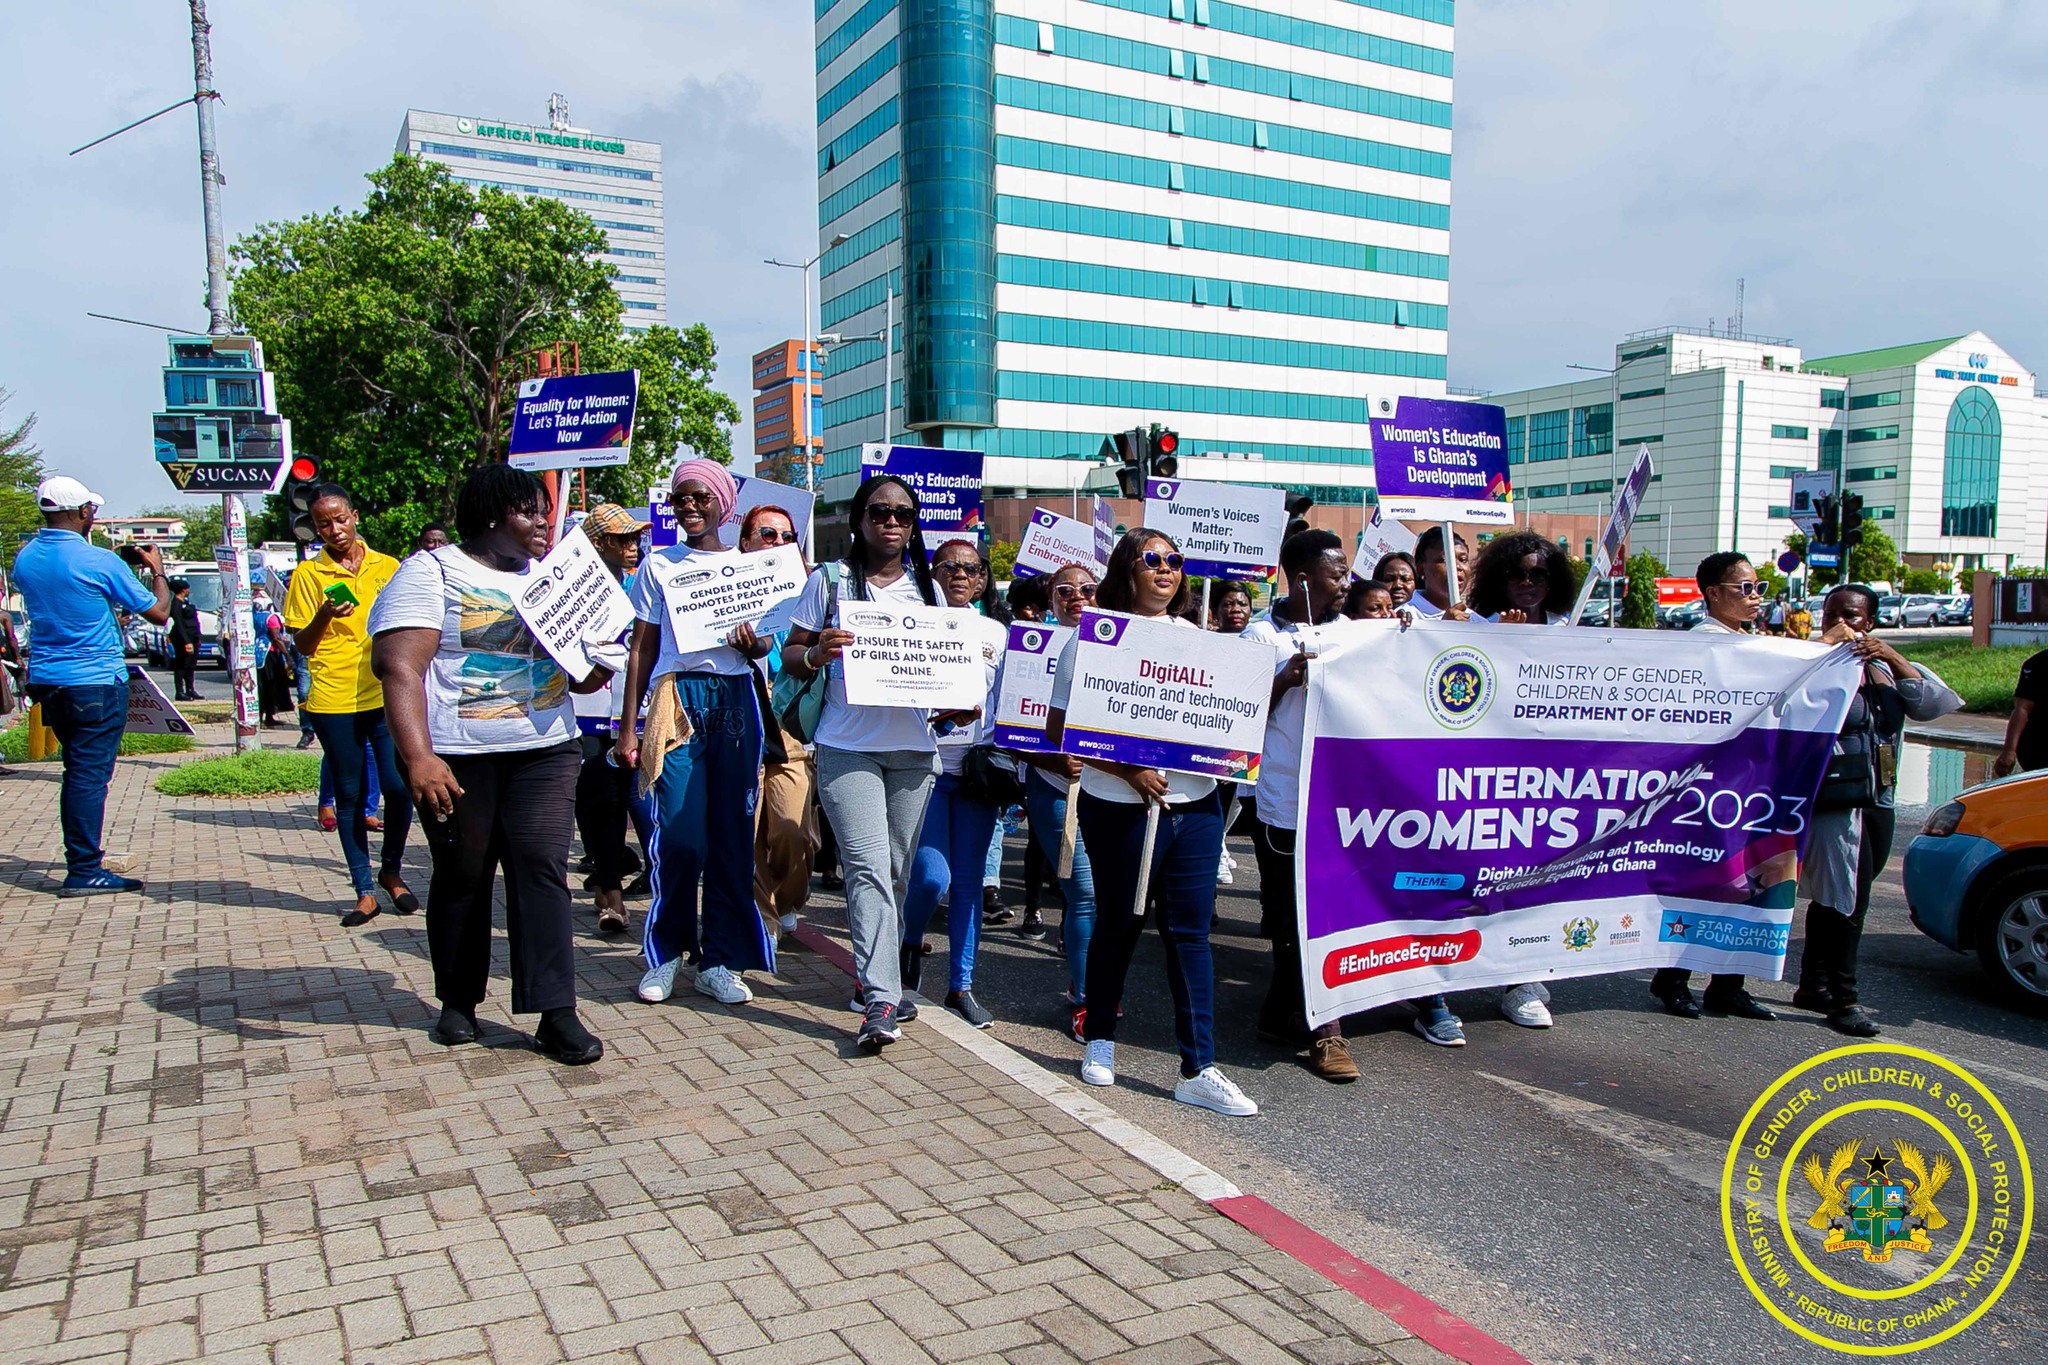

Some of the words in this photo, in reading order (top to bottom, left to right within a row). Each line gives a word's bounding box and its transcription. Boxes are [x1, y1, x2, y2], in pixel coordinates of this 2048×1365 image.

[477, 125, 532, 143] AFRICA
[535, 132, 580, 149] TRADE
[583, 139, 626, 155] HOUSE
[522, 398, 565, 416] Equality
[567, 396, 583, 411] for
[585, 394, 630, 409] Women:
[528, 415, 553, 430] Let's
[555, 414, 580, 428] Take
[582, 411, 618, 427] Action
[557, 430, 582, 444] Now
[1381, 424, 1440, 444] Women's
[1442, 428, 1501, 450] Education
[1413, 446, 1426, 463] is
[1428, 447, 1478, 467] Ghana's
[196, 467, 272, 482] SUCASA
[926, 472, 982, 490] Education
[1406, 465, 1488, 488] Development
[913, 487, 956, 505] hana's
[919, 507, 963, 523] opment
[1168, 502, 1220, 519] Women's
[1223, 508, 1260, 523] Voices
[1466, 509, 1507, 518] #EmbraceEquity
[1033, 530, 1052, 546] End
[1192, 521, 1233, 537] Matter:
[1185, 537, 1230, 554] Amplify
[1232, 541, 1264, 556] Them
[534, 588, 574, 629] IMPLEMENT
[571, 568, 595, 593] GHANAP
[592, 560, 599, 570] 2
[690, 585, 734, 600] GENDER
[736, 575, 775, 590] EQUITY
[545, 626, 557, 640] TO
[555, 597, 588, 630] PROMOTE
[584, 573, 606, 599] WOMEN
[676, 594, 735, 615] PROMOTES
[737, 588, 770, 601] PEACE
[772, 582, 796, 593] AND
[713, 599, 764, 618] SECURITY
[553, 628, 576, 652] PEACE
[575, 616, 589, 632] AND
[588, 585, 615, 618] SECURITY.
[857, 636, 899, 648] ENSURE
[902, 638, 924, 649] THE
[926, 640, 965, 651] SAFETY
[851, 649, 867, 659] OF
[870, 650, 900, 661] GIRLS
[903, 652, 927, 663] AND
[930, 653, 972, 664] WOMEN
[1449, 651, 1475, 659] CHILDREN
[891, 665, 936, 677] ONLINE.
[1139, 659, 1215, 689] DigitALL:
[1478, 659, 1490, 677] SOCIAL
[1518, 663, 1600, 682] MINISTRY
[1603, 666, 1628, 682] OF
[1632, 667, 1707, 687] GENDER,
[1429, 677, 1435, 686] OF
[1083, 672, 1156, 699] Innovation
[1160, 685, 1186, 704] and
[1188, 690, 1260, 719] technology
[1477, 678, 1492, 713] PROTECTION
[1516, 684, 1604, 701] CHILDREN
[1607, 687, 1619, 701] &
[1623, 687, 1687, 705] SOCIAL
[1692, 689, 1785, 707] PROTECTI
[1107, 697, 1126, 714] for
[1130, 701, 1179, 723] gender
[1182, 710, 1234, 734] equality
[1439, 713, 1457, 725] REPUBLIC
[1513, 704, 1628, 722] DEPARTMENT
[1631, 707, 1656, 722] OF
[1659, 708, 1733, 725] GENDER
[1008, 734, 1041, 744] #IWD2023
[1078, 739, 1115, 752] #IWD2023
[1190, 753, 1248, 771] #EmbraceEquity
[1336, 806, 1580, 851] WOMEN'S
[1590, 794, 1675, 843] DAY
[1672, 787, 1808, 836] 2023
[1477, 865, 1543, 884] DigitALL:
[1543, 849, 1605, 874] Innovation
[1606, 842, 1631, 858] and
[1634, 839, 1726, 864] Technology
[1404, 876, 1449, 887] THEME
[1472, 885, 1493, 898] for
[1495, 875, 1543, 893] Gender
[1544, 863, 1594, 884] Equality
[1596, 861, 1608, 874] in
[1612, 858, 1657, 872] Ghana
[1609, 930, 1641, 940] CROSSROADS
[1697, 919, 1734, 933] STAR
[1739, 926, 1788, 939] GHANA
[1508, 934, 1551, 947] Sponsors:
[1695, 930, 1788, 951] FOUNDATION
[1338, 940, 1464, 976] #EmbraceEquity
